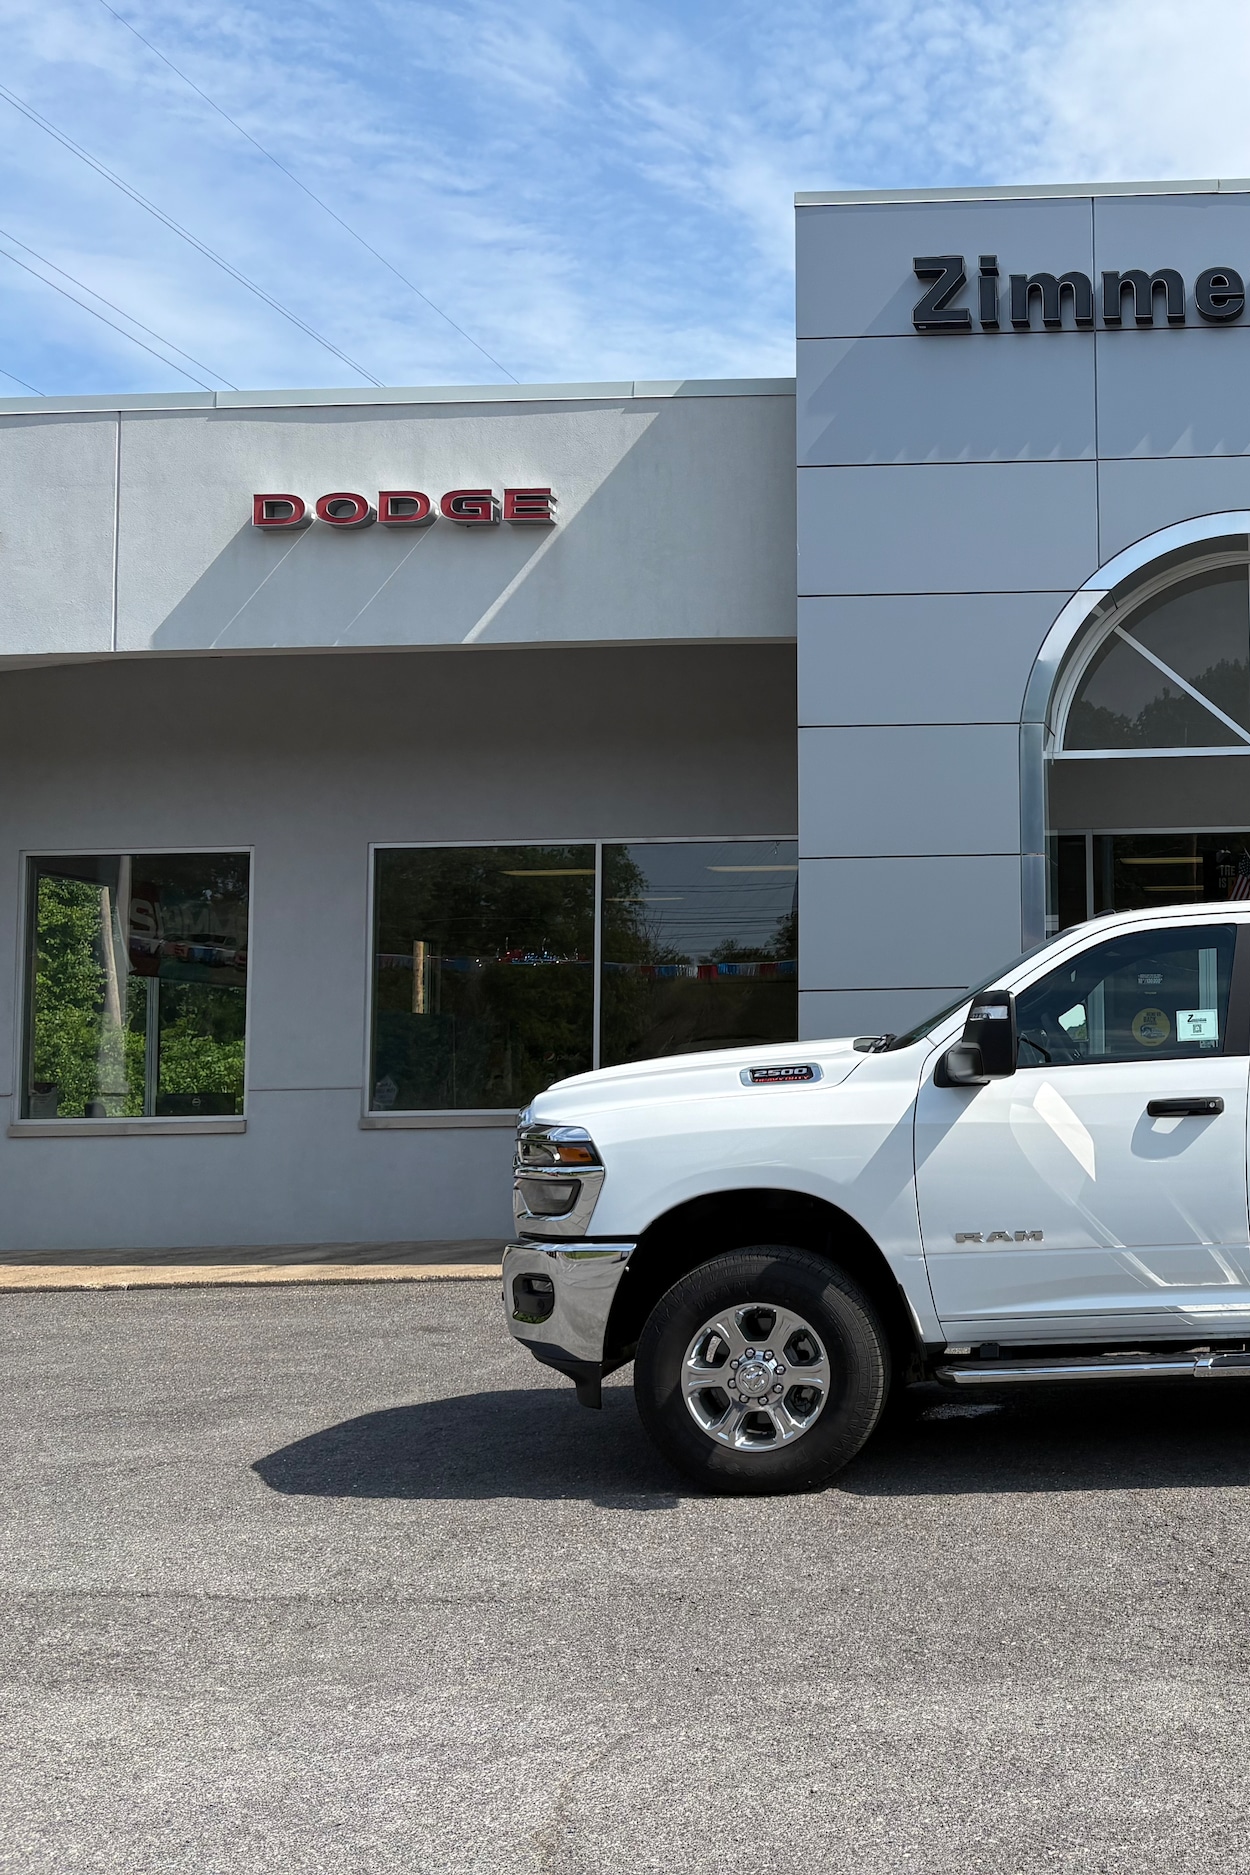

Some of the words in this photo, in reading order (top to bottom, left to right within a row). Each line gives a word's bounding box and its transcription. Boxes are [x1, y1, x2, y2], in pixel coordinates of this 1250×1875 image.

[252, 487, 556, 530] DODGE
[754, 1067, 808, 1078] 2500
[955, 1230, 1044, 1243] RAM
